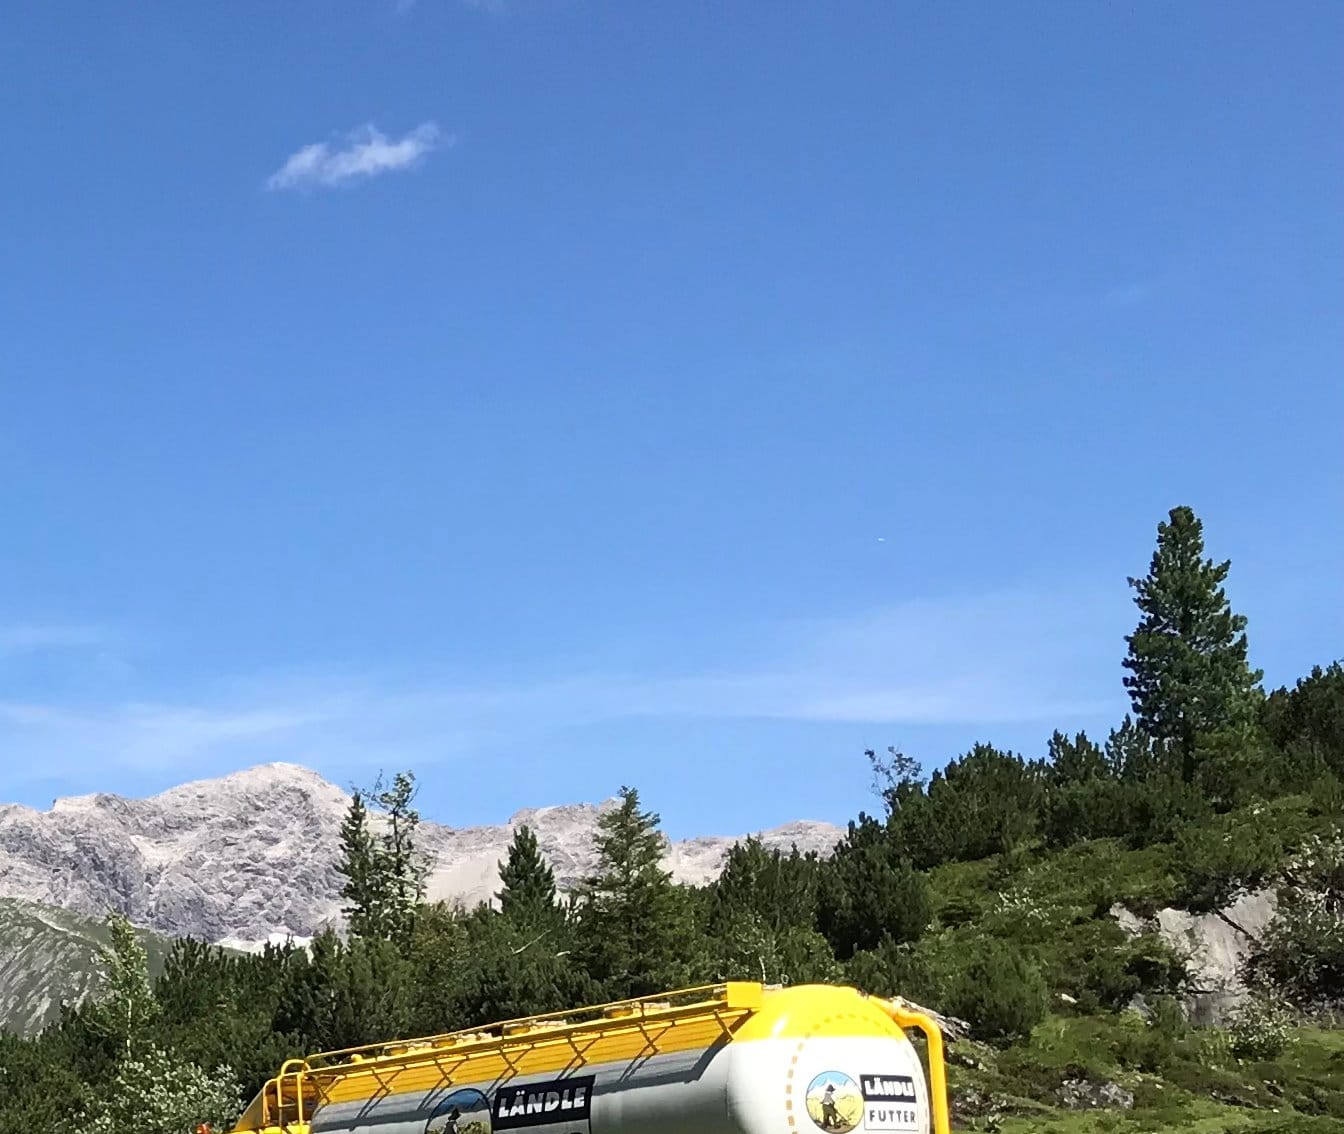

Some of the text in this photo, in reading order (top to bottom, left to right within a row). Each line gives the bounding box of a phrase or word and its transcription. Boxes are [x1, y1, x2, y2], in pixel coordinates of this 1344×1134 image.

[864, 1077, 915, 1097] LÄNDLE
[498, 1087, 587, 1118] LÄNDLE
[869, 1110, 916, 1123] FUTTER
